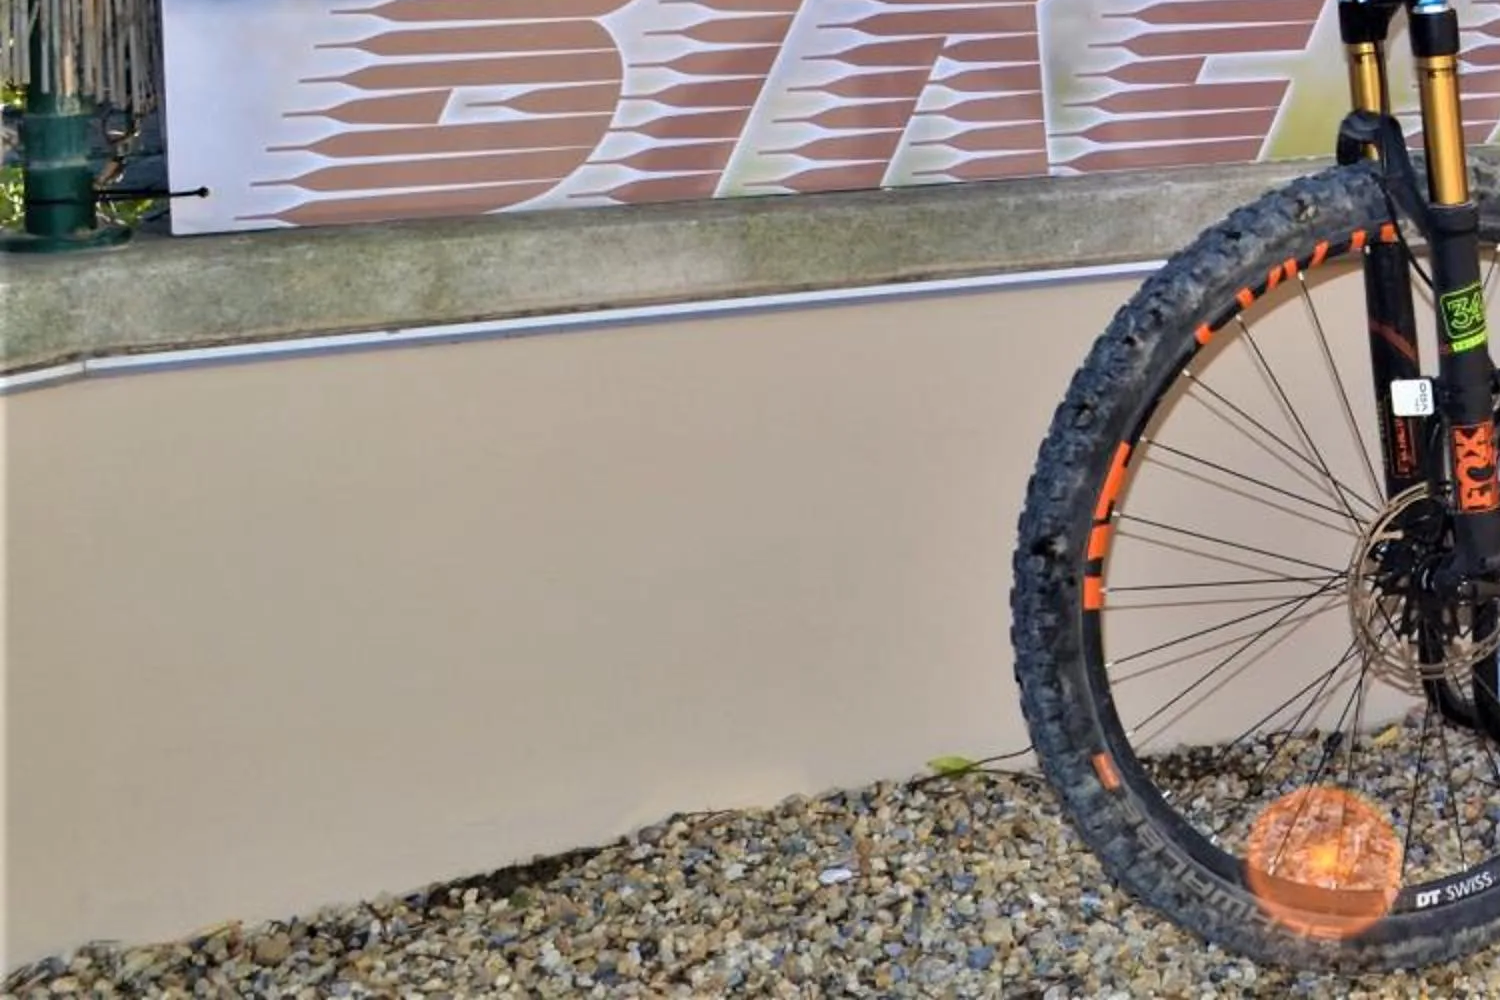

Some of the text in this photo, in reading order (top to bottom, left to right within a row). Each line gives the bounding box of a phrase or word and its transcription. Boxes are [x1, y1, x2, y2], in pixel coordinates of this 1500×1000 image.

[1447, 292, 1484, 330] 34
[1416, 871, 1493, 908] DT SWISS
